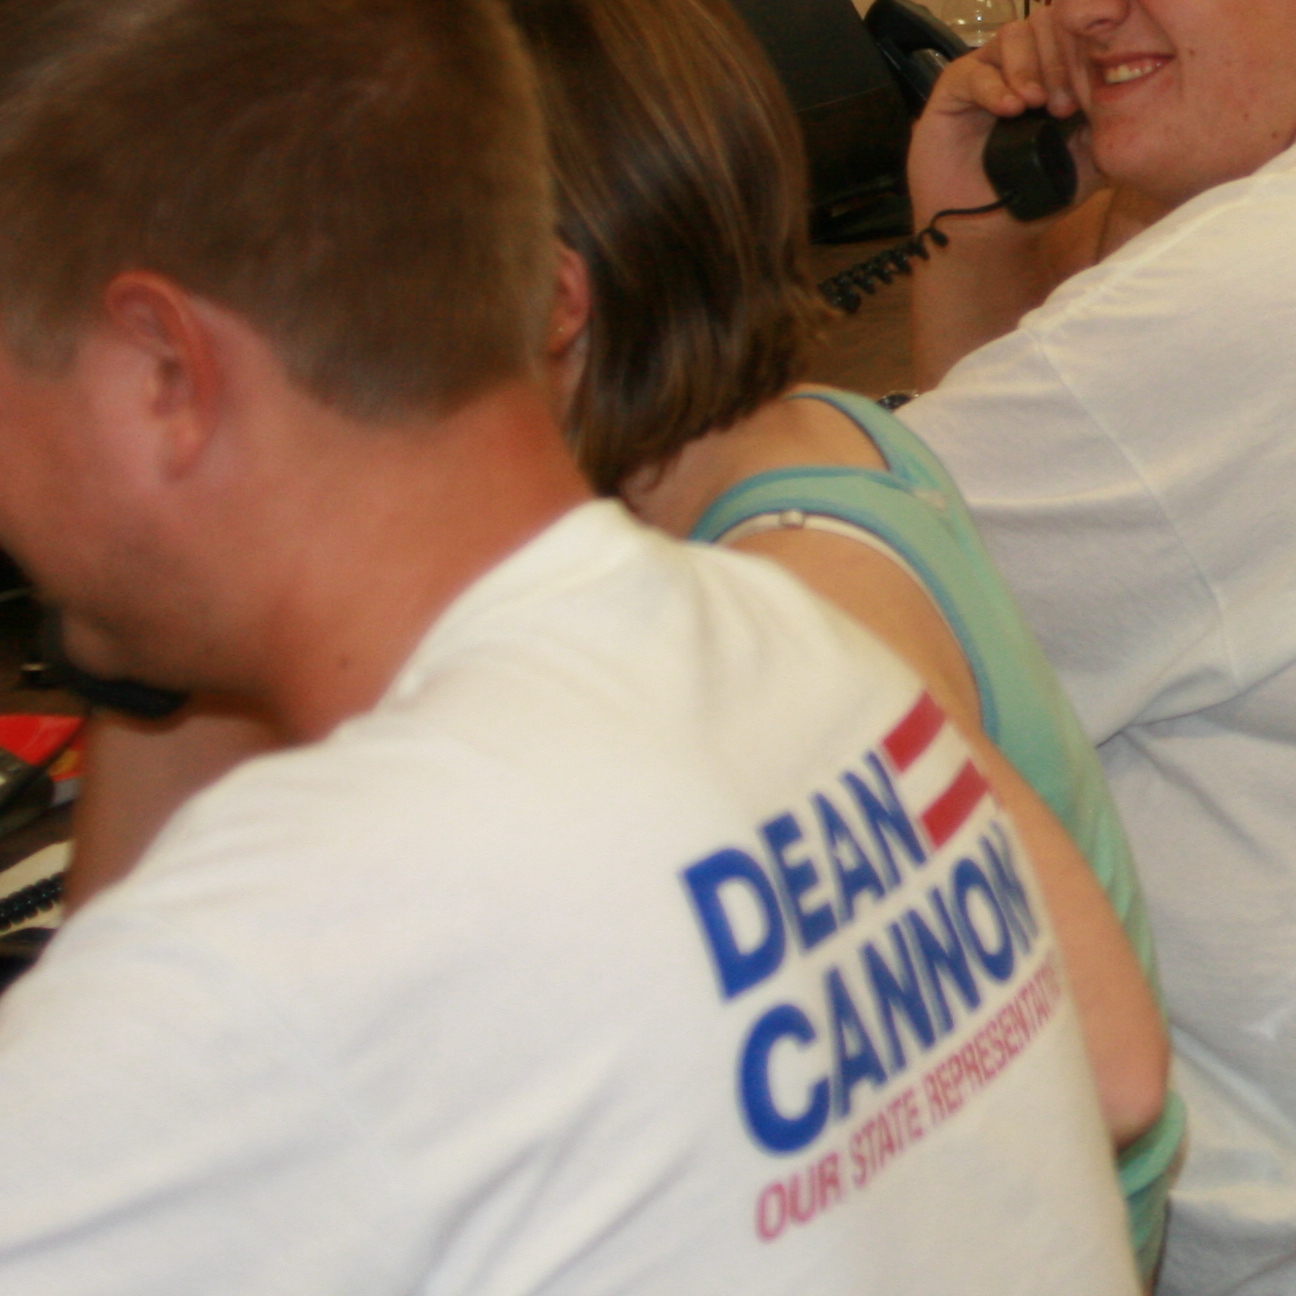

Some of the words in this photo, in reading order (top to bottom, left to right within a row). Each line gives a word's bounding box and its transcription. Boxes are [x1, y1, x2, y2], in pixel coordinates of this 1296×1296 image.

[678, 748, 928, 1002] DEAN
[735, 819, 1042, 1157] CANNON
[754, 1149, 848, 1244] OUR
[847, 1085, 926, 1189] STATE
